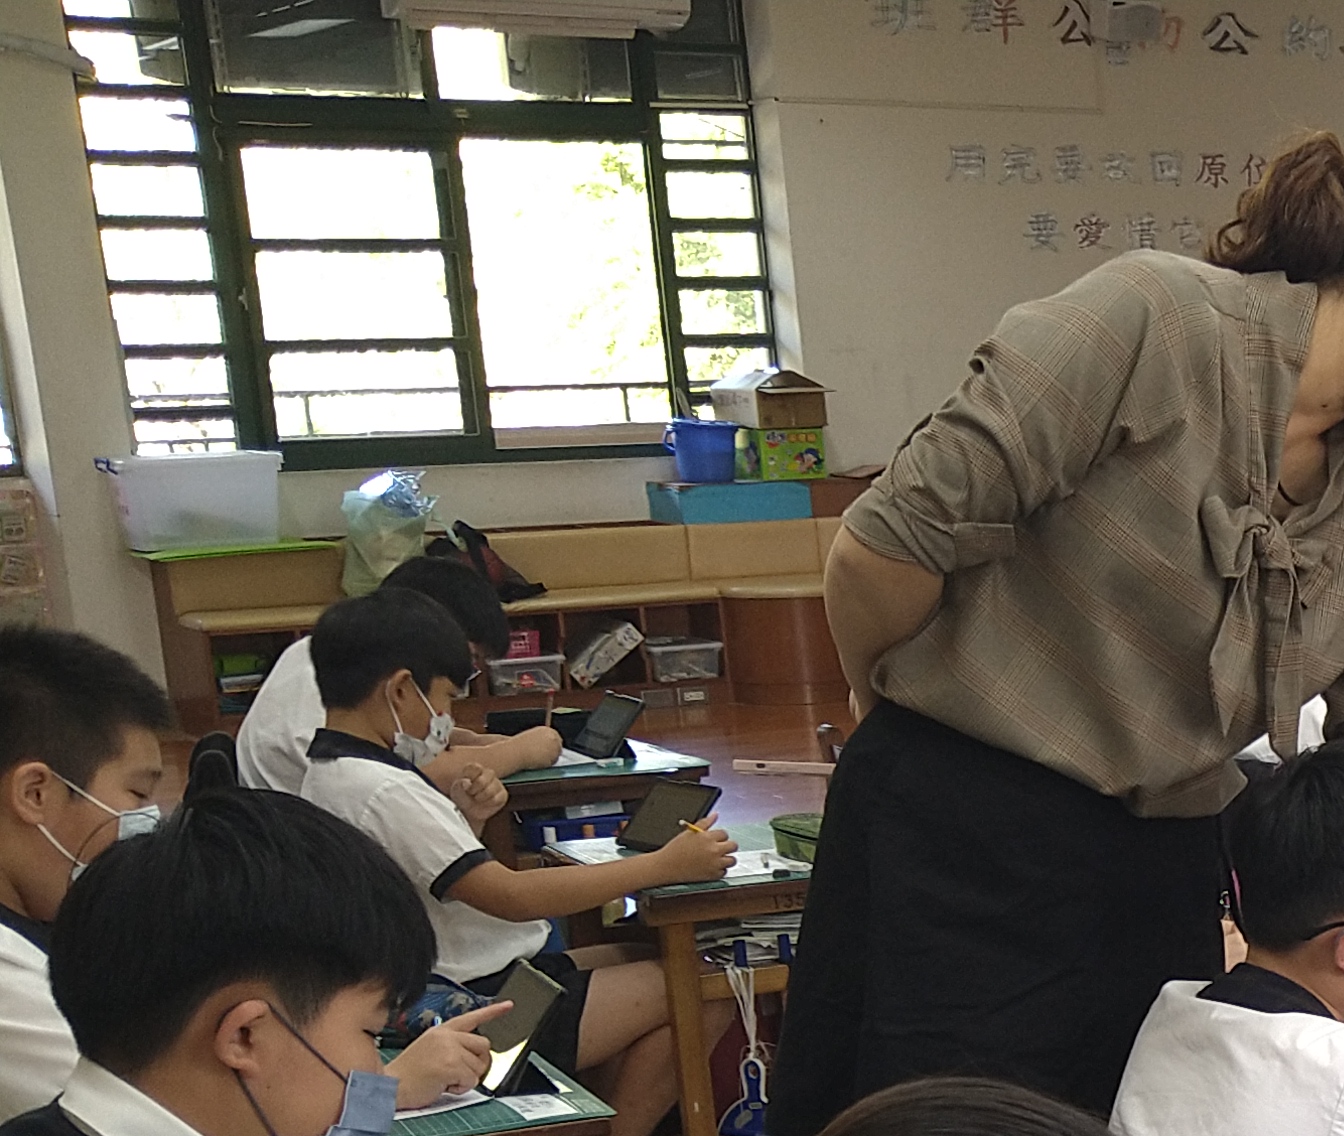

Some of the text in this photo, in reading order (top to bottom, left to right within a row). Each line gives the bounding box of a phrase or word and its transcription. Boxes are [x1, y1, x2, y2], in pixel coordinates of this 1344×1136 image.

[870, 0, 1332, 61] 班群公公約
